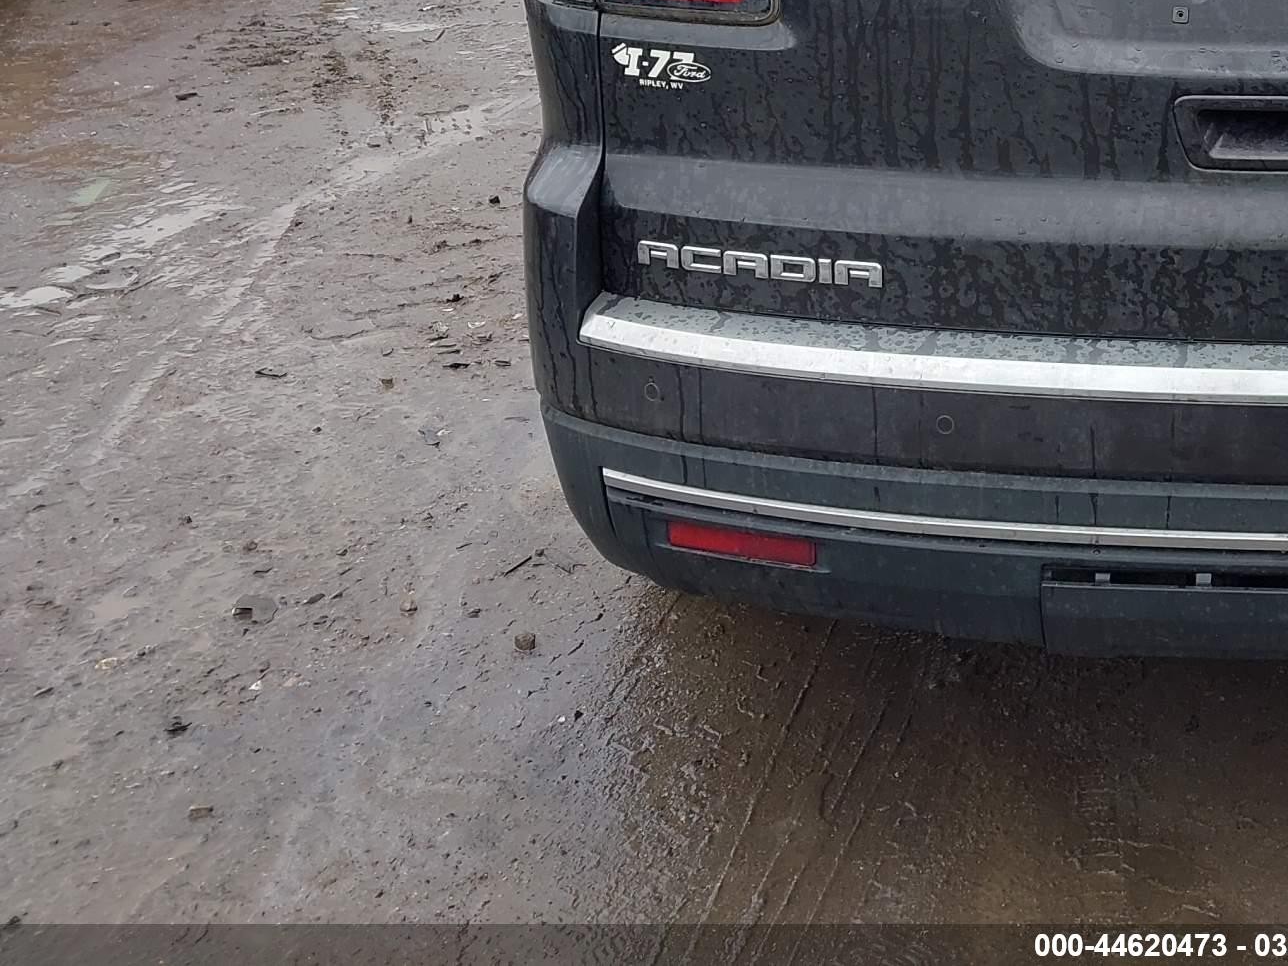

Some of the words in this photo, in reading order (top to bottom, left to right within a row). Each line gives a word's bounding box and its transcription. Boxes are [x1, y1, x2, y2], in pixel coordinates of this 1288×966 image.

[673, 64, 706, 79] Ford
[639, 78, 668, 90] RIPLEY,
[670, 81, 684, 90] WV
[637, 240, 883, 289] ACADIA
